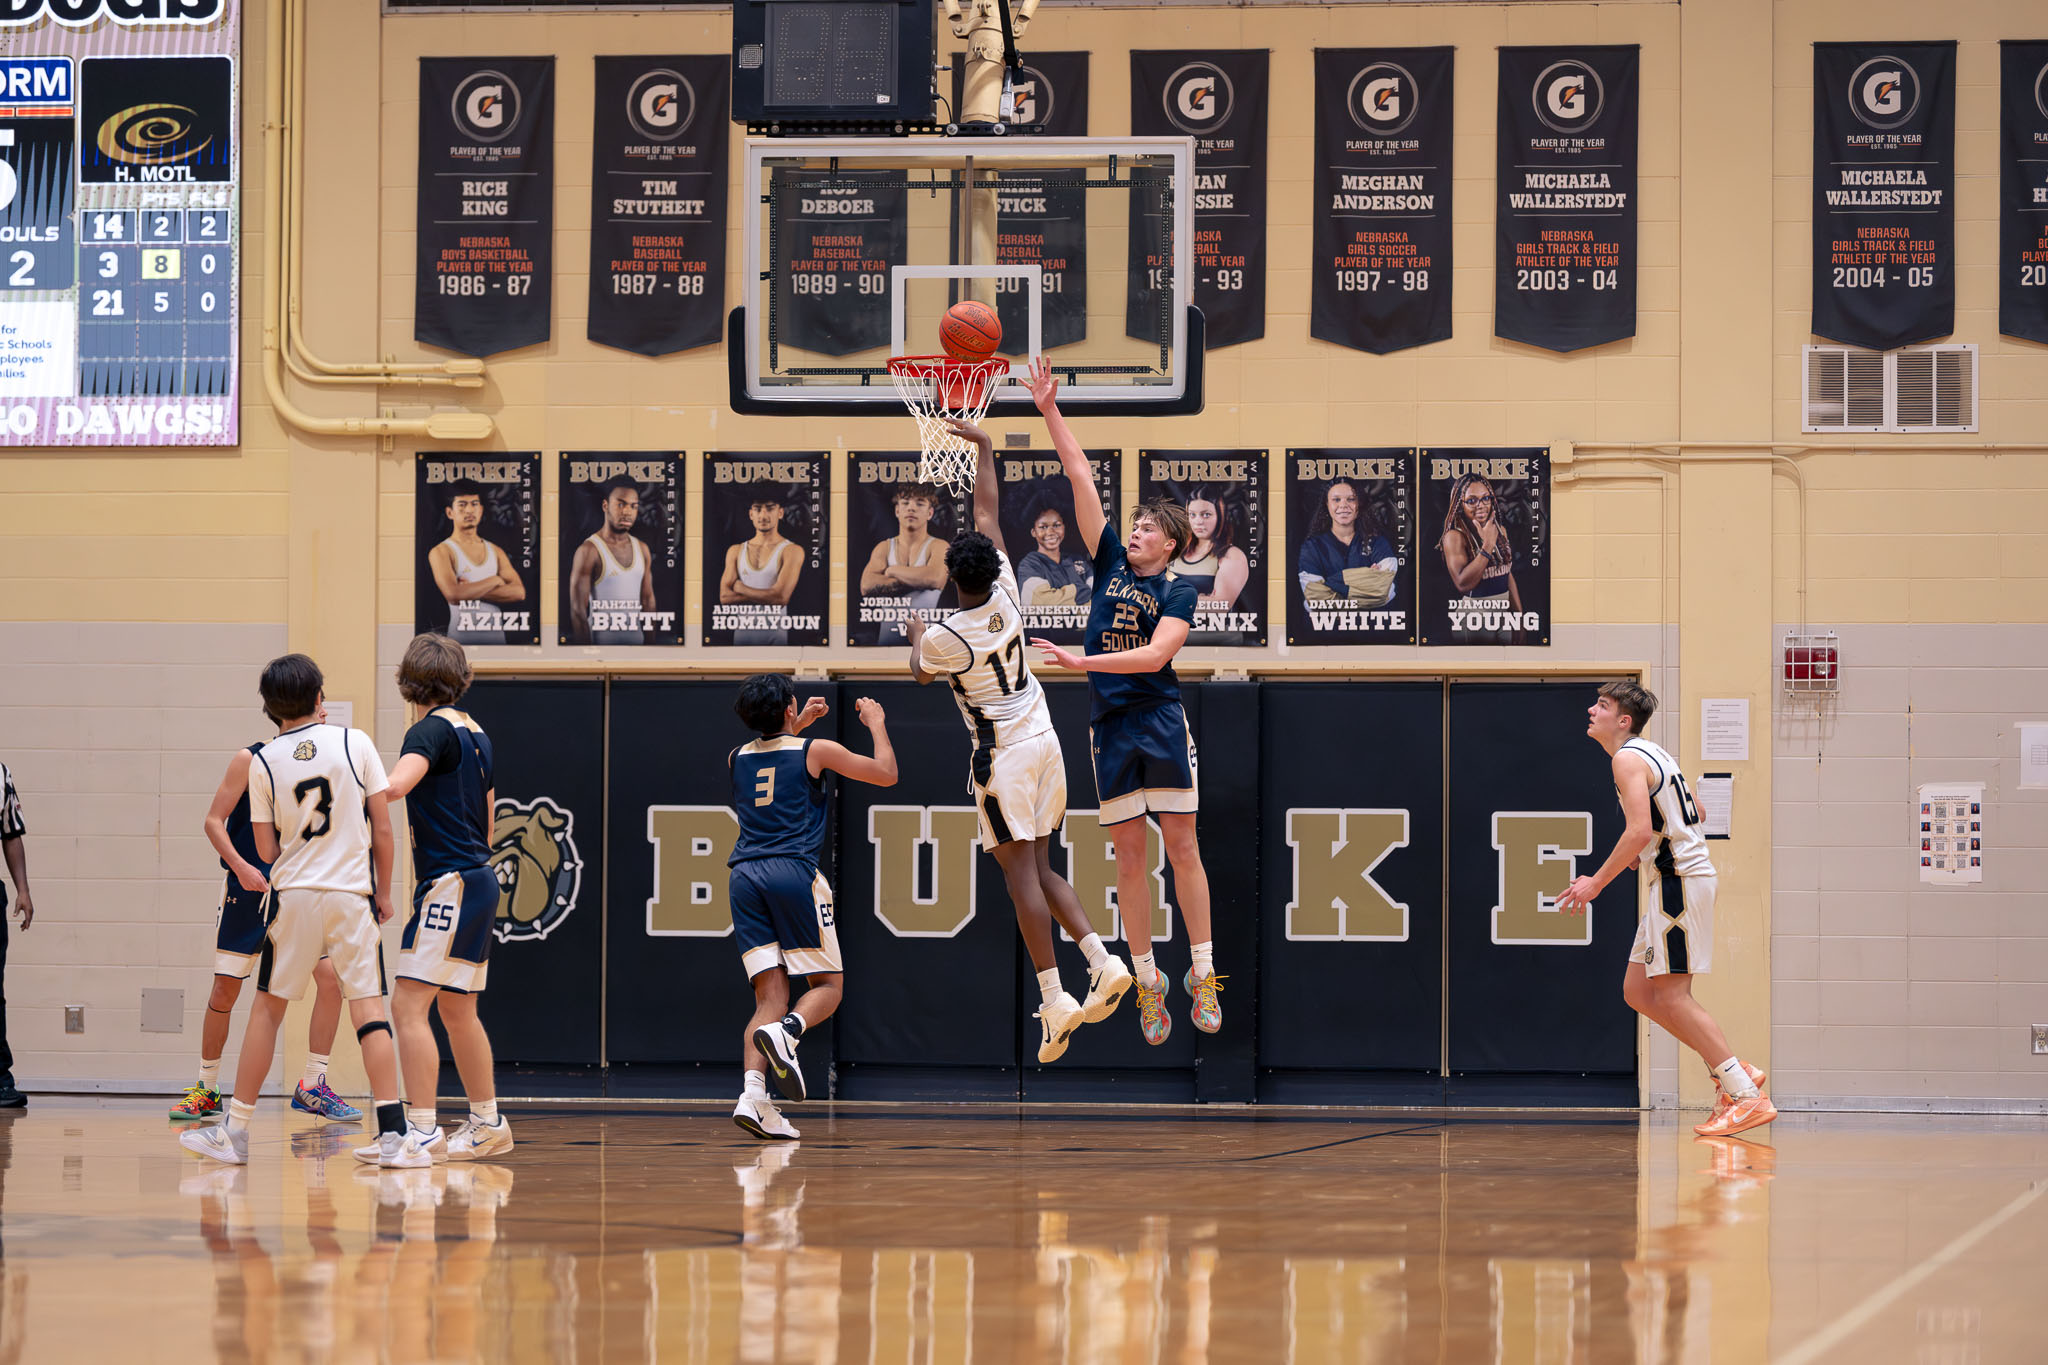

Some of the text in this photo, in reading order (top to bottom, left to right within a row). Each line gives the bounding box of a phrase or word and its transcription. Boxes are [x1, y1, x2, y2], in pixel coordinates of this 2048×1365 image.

[0, 67, 66, 97] RM
[1178, 77, 1216, 120] G
[1362, 77, 1401, 121] G
[1547, 75, 1585, 119] G
[1863, 71, 1902, 114] G
[466, 85, 503, 128] G
[640, 84, 678, 127] G
[1346, 141, 1372, 149] PLAYER
[1401, 140, 1418, 148] YEAR
[1531, 139, 1605, 147] PLAYER OF THE YEAR
[1847, 135, 1921, 143] PLAYER OF THE YEAR
[115, 166, 196, 182] H. MOTL
[1525, 173, 1611, 188] MICHAELA
[1841, 170, 1927, 185] MICHAELA
[462, 181, 508, 196] RICH
[642, 181, 677, 195] TIM
[1342, 175, 1424, 190] MEGHAN
[1333, 195, 1434, 210] ANDERSON
[1510, 193, 1626, 208] WALLERSTEDT
[1826, 190, 1942, 205] WALLERSTEDT
[462, 200, 508, 216] KING
[614, 199, 704, 215] STUTHEIT
[801, 199, 874, 214] DEBOER
[94, 214, 216, 239] 14 2 2
[1857, 227, 1909, 238] NEBRASKA
[460, 237, 510, 248] NEBRASKA
[633, 236, 684, 247] NEBRASKA
[812, 236, 863, 246] NEBRASKA
[1356, 232, 1408, 243] NEBRASKA
[1541, 230, 1594, 241] NEBRASKA
[813, 248, 861, 258] BASEBALL
[1348, 244, 1416, 255] GIRLS SOCCER
[1517, 243, 1619, 254] GIRLS TRACK & FIELD
[1833, 240, 1935, 251] GIRLS TRACK & FIELD
[442, 249, 528, 260] BOYS BASKETBALL
[634, 248, 682, 260] BASEBALL
[1516, 256, 1619, 267] ATHLETE OF THE YEAR
[1832, 253, 1935, 264] ATHLETE OF THE YEAR
[9, 250, 35, 286] 2
[99, 252, 216, 278] 3 8 0
[437, 261, 533, 272] PLAYER OF THE YEAR
[611, 260, 706, 272] PLAYER OF THE YEAR
[792, 260, 886, 271] PLAYER OF THE YEAR
[1043, 259, 1066, 269] YEAR
[1335, 257, 1431, 268] PLAYER OF THE YEAR
[612, 274, 704, 295] 1987 88
[791, 274, 884, 294] 1989 90
[1043, 273, 1063, 293] 91
[1217, 270, 1242, 290] 93
[1336, 270, 1428, 291] 1997 98
[1517, 269, 1617, 290] 2003 04
[1833, 267, 1933, 287] 2004 05
[438, 275, 531, 296] 1986 87
[93, 290, 215, 315] 21 5 0
[1, 325, 16, 334] for
[8, 340, 52, 349] Schools
[56, 404, 223, 435] DAWGS!
[426, 462, 521, 484] BURKE
[570, 462, 665, 483] BURKE
[714, 462, 810, 484] BURKE
[1004, 461, 1100, 481] BURE
[1150, 460, 1247, 481] BURKE
[1297, 459, 1395, 480] BURKE
[1431, 459, 1529, 480] BURKE
[522, 462, 531, 568] WRESTLING
[667, 462, 675, 568] WRESTLING
[811, 462, 820, 569] WRESTLING
[1531, 459, 1539, 566] WRESTLING
[458, 600, 480, 610] ALI
[591, 600, 643, 610] RAHZEL
[860, 597, 911, 606] JORDAN
[1309, 600, 1358, 610] DAYVIE
[1448, 600, 1510, 610] DIAMOND
[713, 605, 782, 615] ABDULLAH
[860, 608, 960, 622] RODRIGUE
[1112, 602, 1140, 631] 23
[457, 612, 530, 631] AZIZI
[591, 612, 675, 631] BRITT
[712, 615, 821, 630] HOMAYOUN
[1309, 611, 1406, 631] WHITE
[1448, 612, 1539, 631] YOUNG
[1102, 632, 1147, 651] SOUTH
[984, 634, 1027, 696] 12
[755, 766, 776, 807] 3
[293, 775, 332, 842] 3
[424, 903, 454, 932] ES
